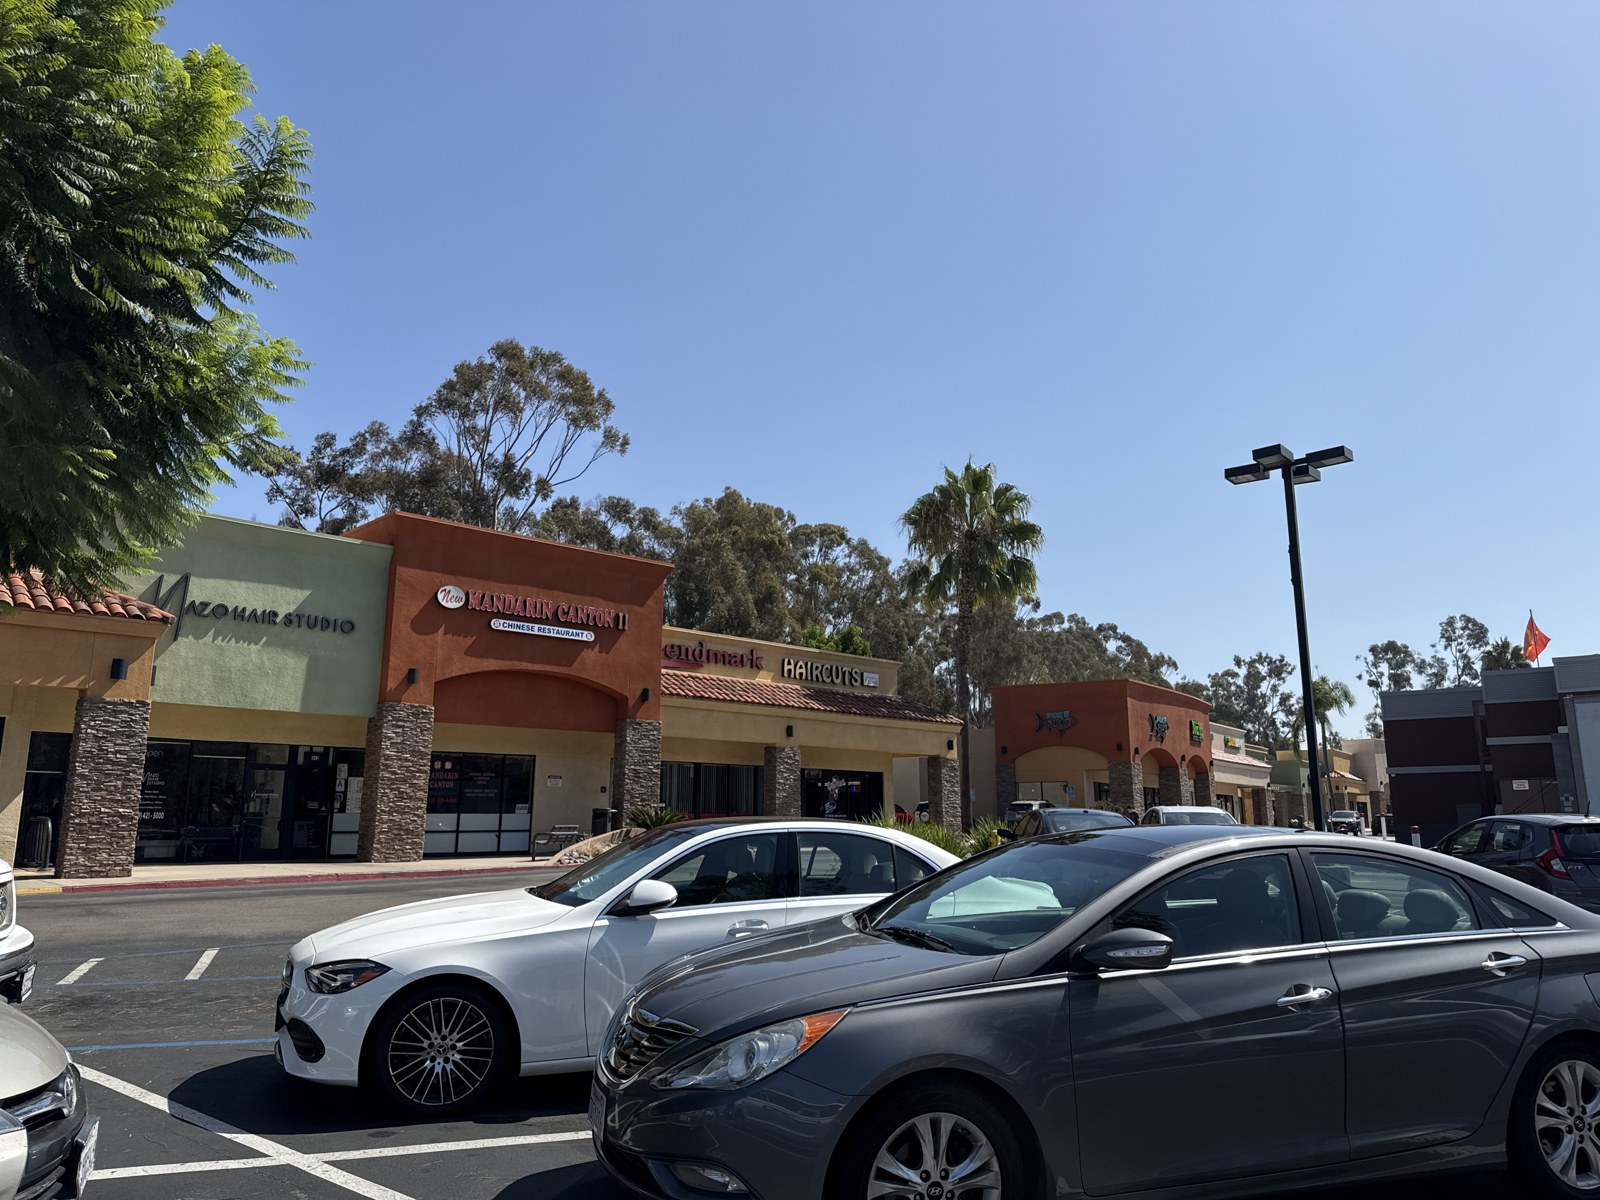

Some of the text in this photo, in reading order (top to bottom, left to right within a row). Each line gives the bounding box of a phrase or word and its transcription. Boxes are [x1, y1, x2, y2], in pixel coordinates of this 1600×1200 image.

[440, 588, 464, 604] New
[468, 590, 630, 631] MANDARIN CANTON II
[233, 605, 278, 625] HAIR
[283, 611, 356, 634] STUDIO
[502, 621, 585, 639] CHINESE RESTAURANT
[661, 641, 764, 670] endmark
[783, 658, 862, 687] HAIRCUTS
[146, 750, 163, 758] pen
